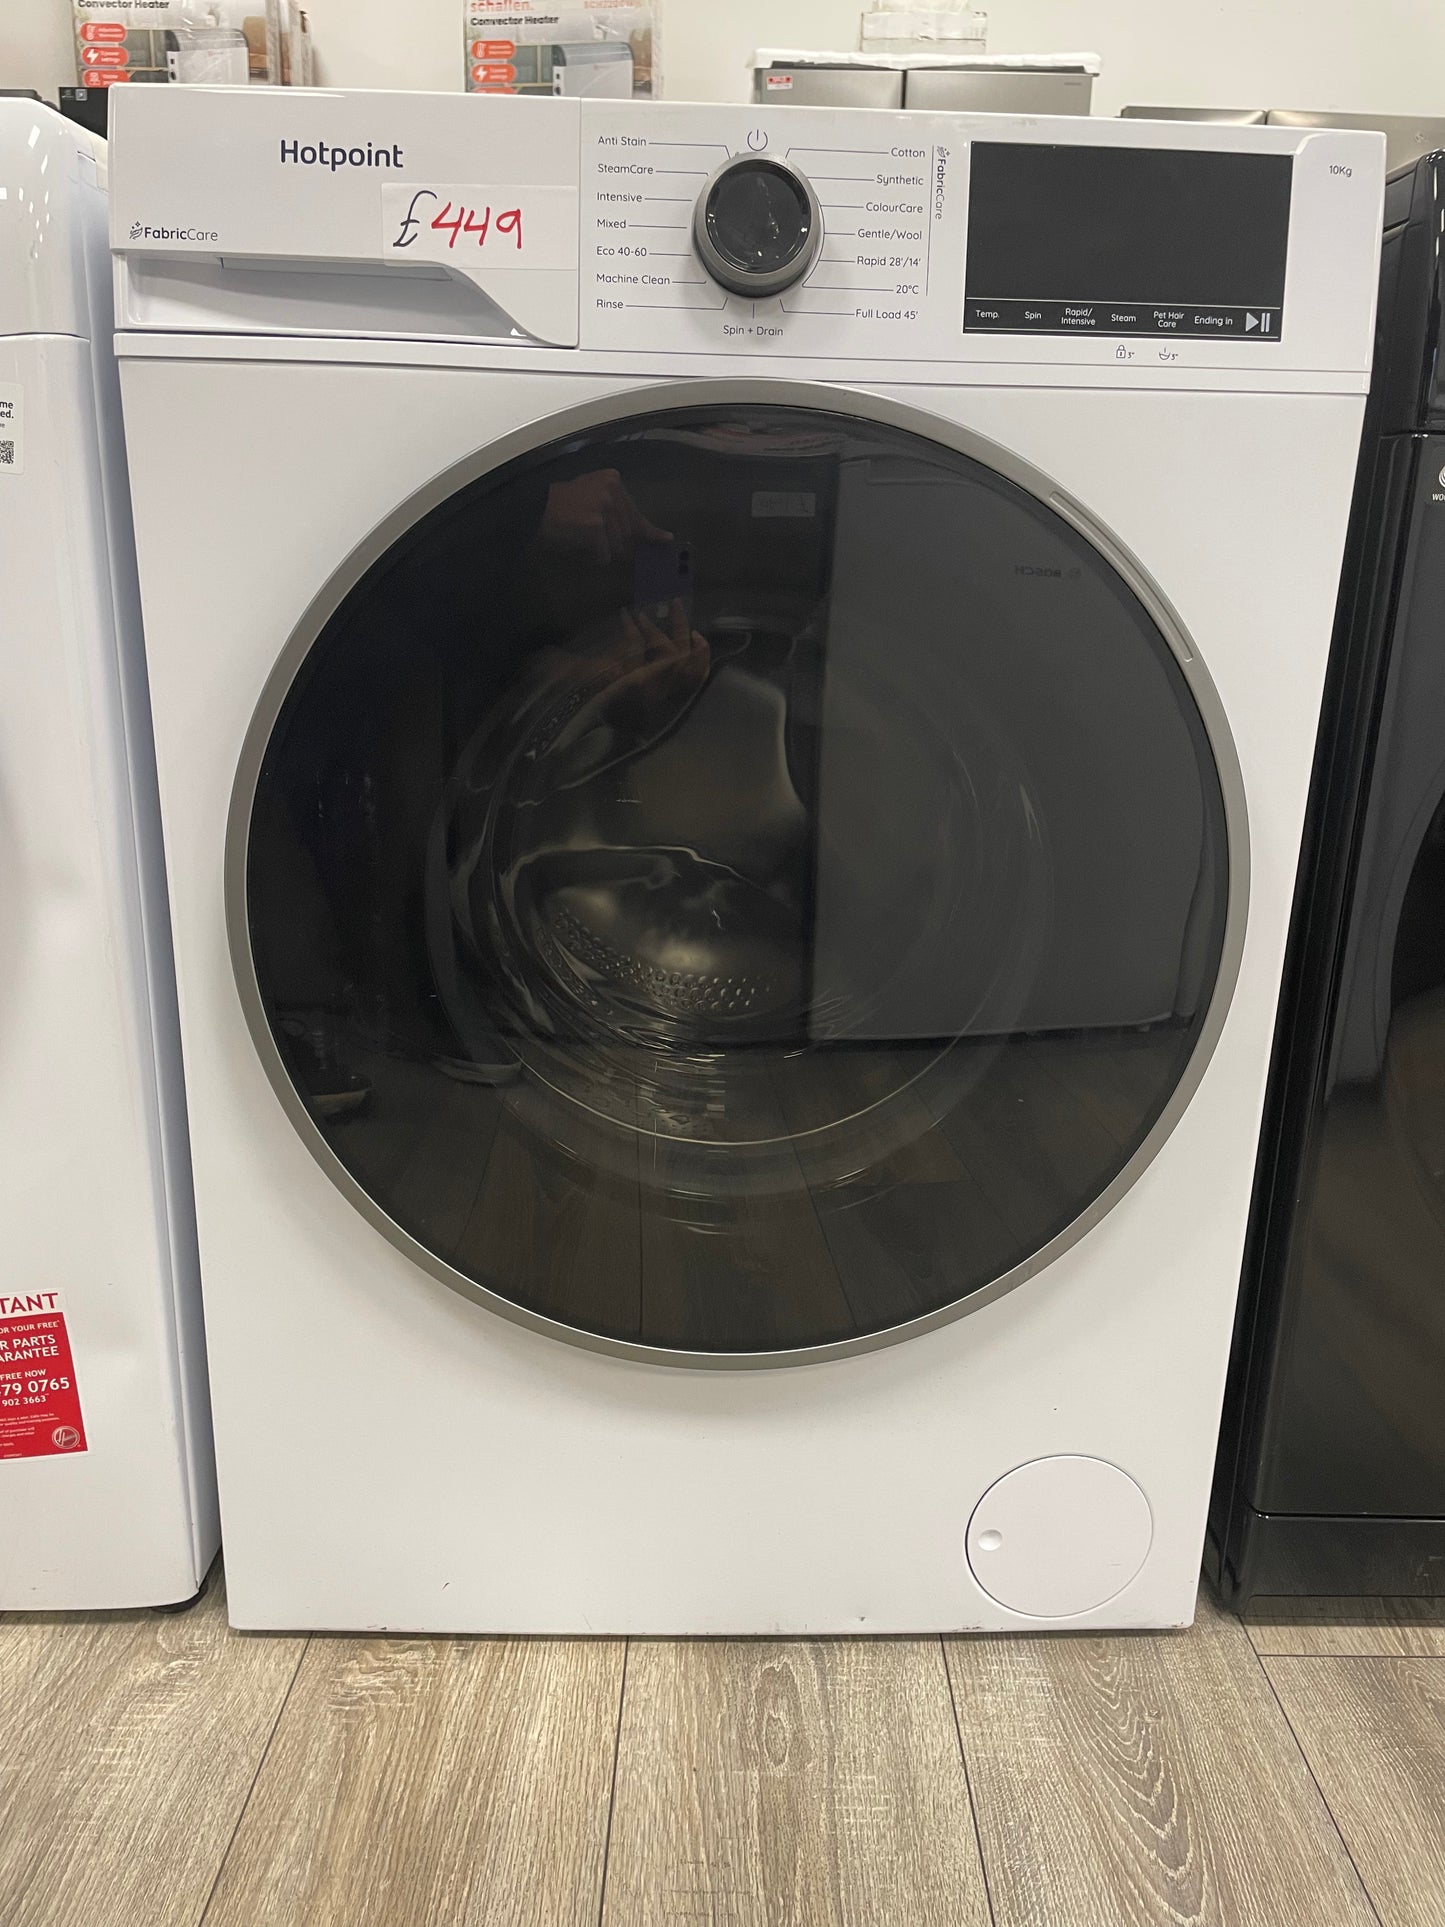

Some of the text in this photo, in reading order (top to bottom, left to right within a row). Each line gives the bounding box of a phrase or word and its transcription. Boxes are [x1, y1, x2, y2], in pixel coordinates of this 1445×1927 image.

[78, 0, 170, 8] Convector Heater
[474, 16, 559, 26] Convector Heater
[597, 135, 647, 147] Anti Stain
[281, 139, 404, 171] Hotpoint
[890, 147, 926, 158] Cotton
[597, 163, 654, 175] SteamCare
[1329, 164, 1354, 178] 10Kg
[876, 174, 925, 187] Synthetic
[935, 158, 946, 220] FabricCare
[597, 192, 643, 203] Intensive
[865, 201, 924, 214] ColourCare
[393, 190, 523, 250] £449
[597, 218, 627, 229] Mixed
[144, 226, 219, 242] FabricCare
[857, 228, 923, 240] Gentle/Wool
[596, 245, 647, 257] Eco 40-60
[856, 255, 887, 268] Rapid
[596, 273, 671, 285] Machine Clean
[596, 298, 624, 309] Rinse
[855, 308, 873, 319] Full
[876, 309, 901, 320] Load
[975, 309, 1000, 319] Temp.
[1024, 310, 1042, 320] Spin
[1065, 307, 1093, 318] Rapid/
[1111, 313, 1137, 322] Steam
[1153, 311, 1185, 320] Pet Hair
[1061, 316, 1096, 326] Intensive
[1157, 319, 1177, 328] Care
[1194, 315, 1233, 327] Ending in
[723, 324, 747, 337] Spin
[756, 325, 784, 336] Drain
[0, 1292, 58, 1314] TANT
[11, 1324, 35, 1332] YOUR
[13, 1334, 56, 1349] PARTS
[0, 1369, 46, 1380] FREE NOW
[0, 1376, 70, 1396] 79 0765
[2, 1398, 20, 1407] 902
